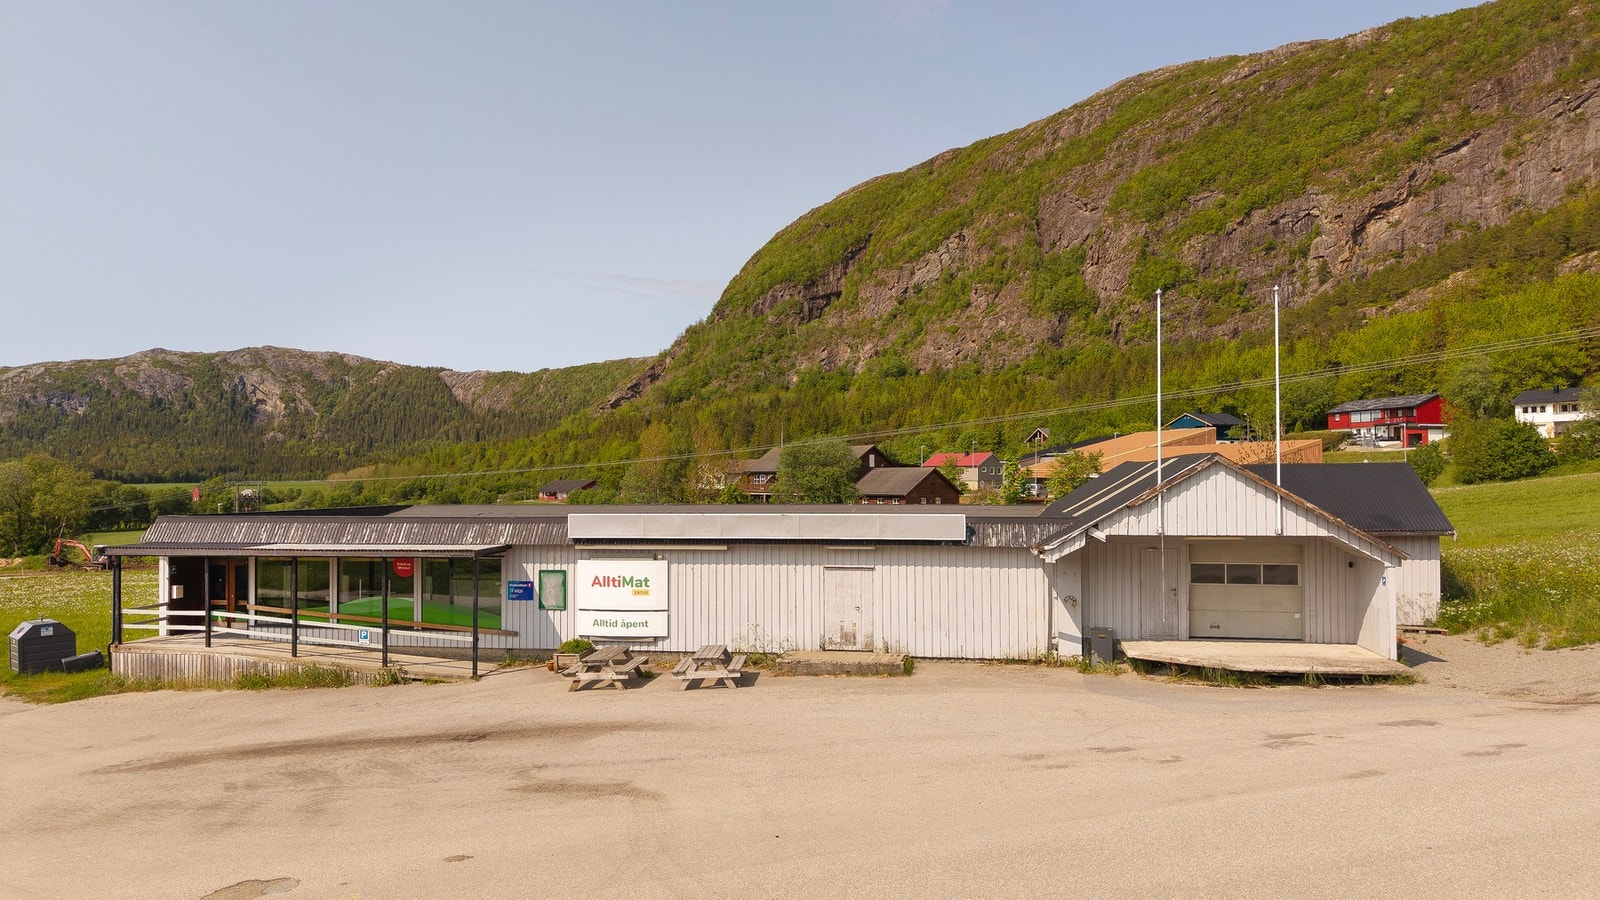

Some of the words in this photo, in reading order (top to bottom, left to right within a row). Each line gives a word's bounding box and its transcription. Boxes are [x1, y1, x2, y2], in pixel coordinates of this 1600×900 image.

[591, 575, 650, 588] AlltiMat
[592, 618, 618, 628] Alltid
[620, 618, 649, 630] åpent
[361, 631, 367, 639] P
